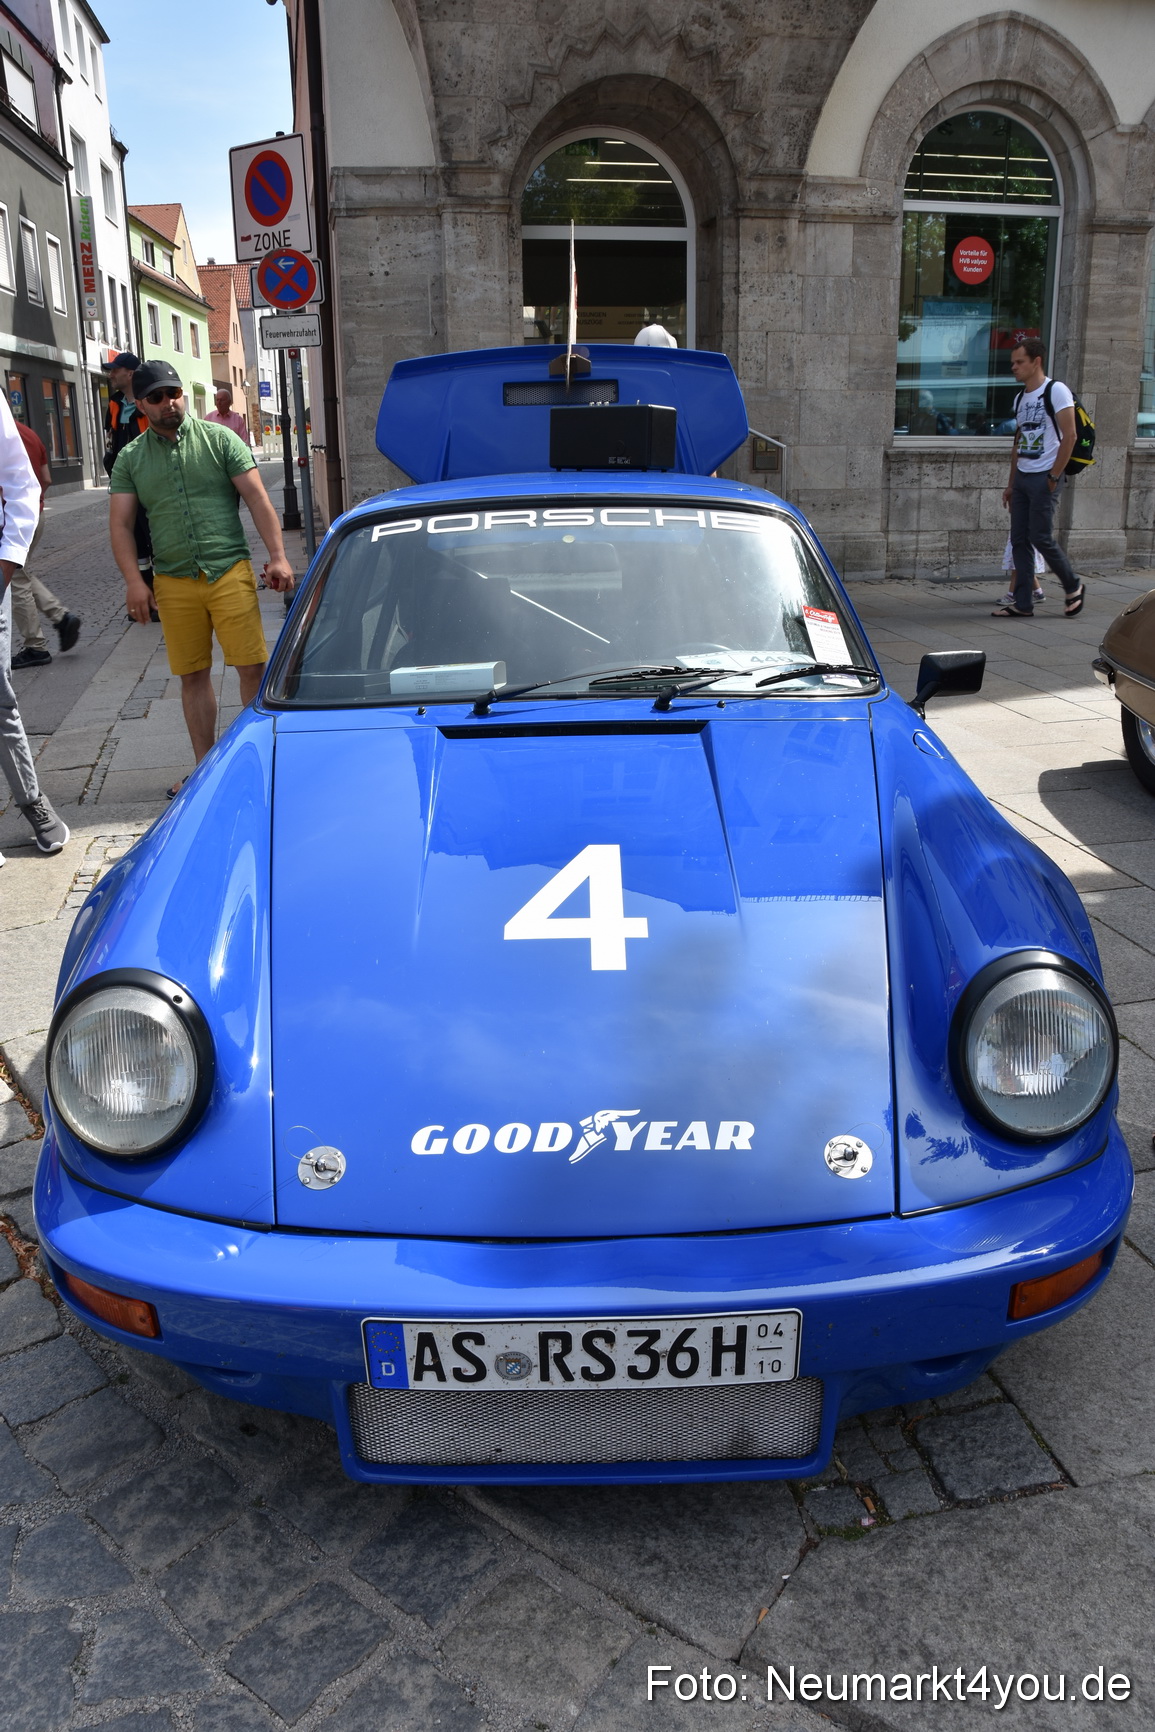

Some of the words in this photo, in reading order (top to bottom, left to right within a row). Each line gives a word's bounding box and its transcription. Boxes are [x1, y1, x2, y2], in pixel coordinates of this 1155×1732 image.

[79, 198, 91, 241] Reisen
[254, 229, 292, 252] ZONE
[80, 242, 96, 293] MERZ
[265, 328, 317, 339] Feuerwehrzufahrt
[371, 507, 764, 542] PORSCHE
[503, 844, 649, 971] 4
[757, 1322, 784, 1338] 04
[382, 1362, 396, 1376] D
[413, 1331, 487, 1383] AS
[758, 1359, 782, 1375] 10
